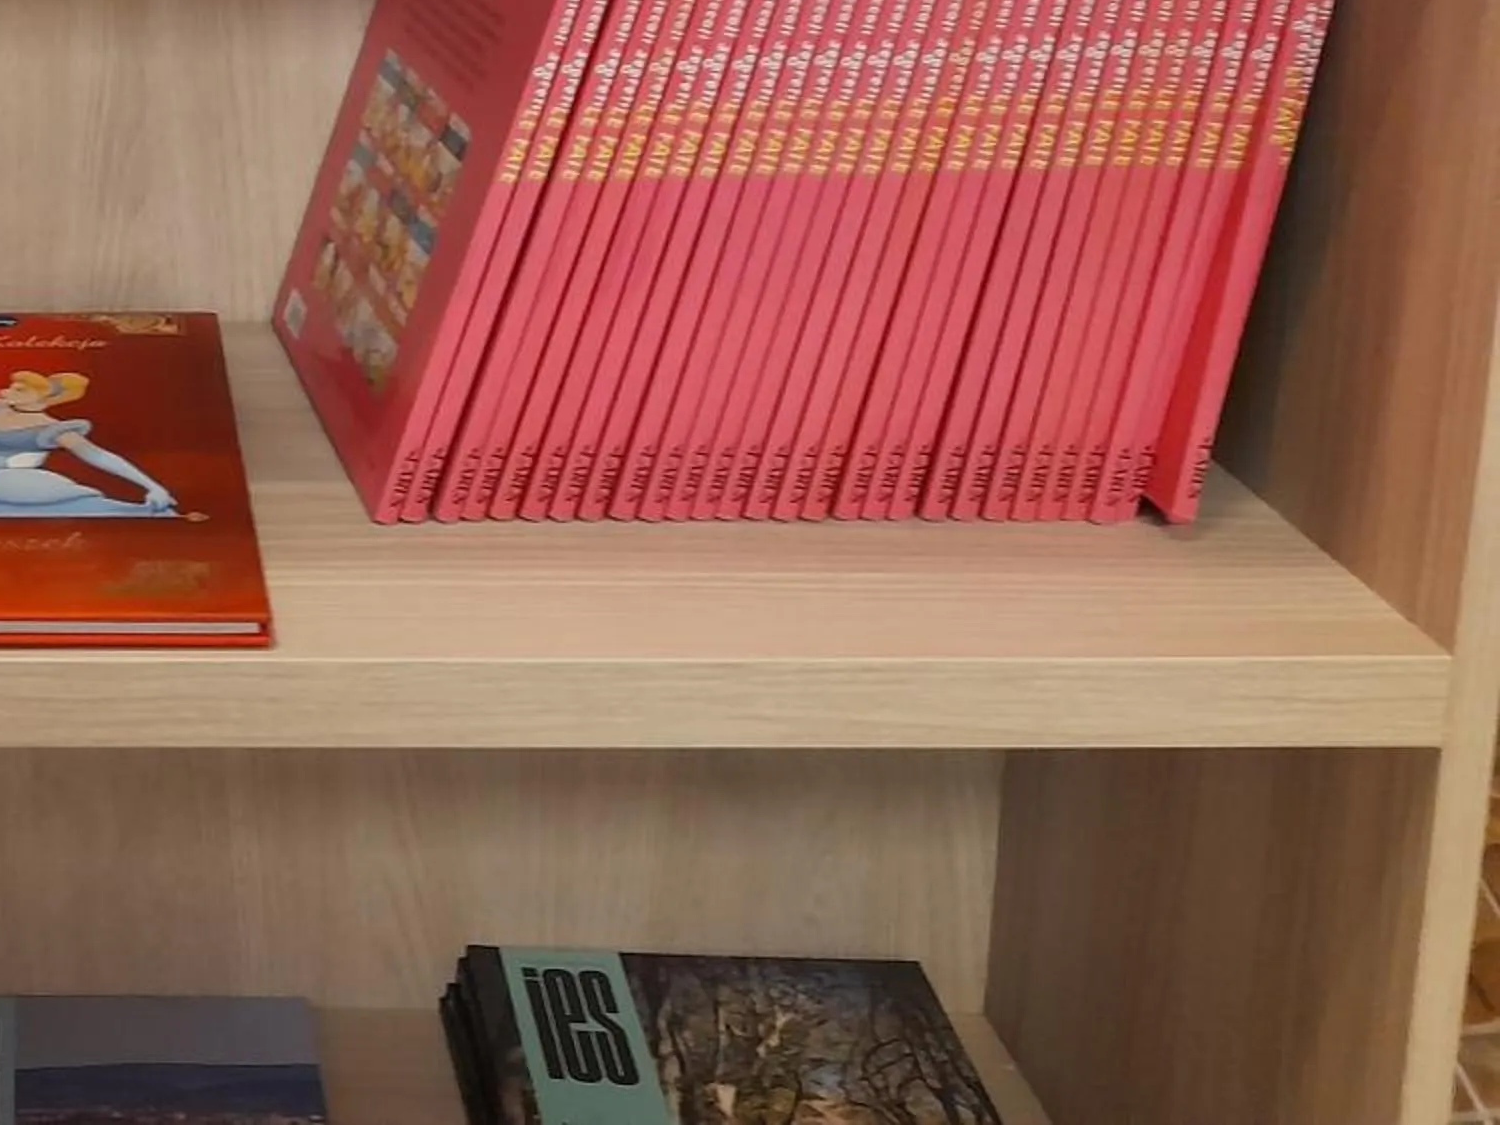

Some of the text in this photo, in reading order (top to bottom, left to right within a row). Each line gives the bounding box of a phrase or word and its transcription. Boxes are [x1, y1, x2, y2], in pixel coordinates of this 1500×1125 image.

[529, 52, 559, 112] segreti
[698, 43, 729, 106] segreti
[837, 42, 866, 104] segreti
[1253, 34, 1277, 92] segreti
